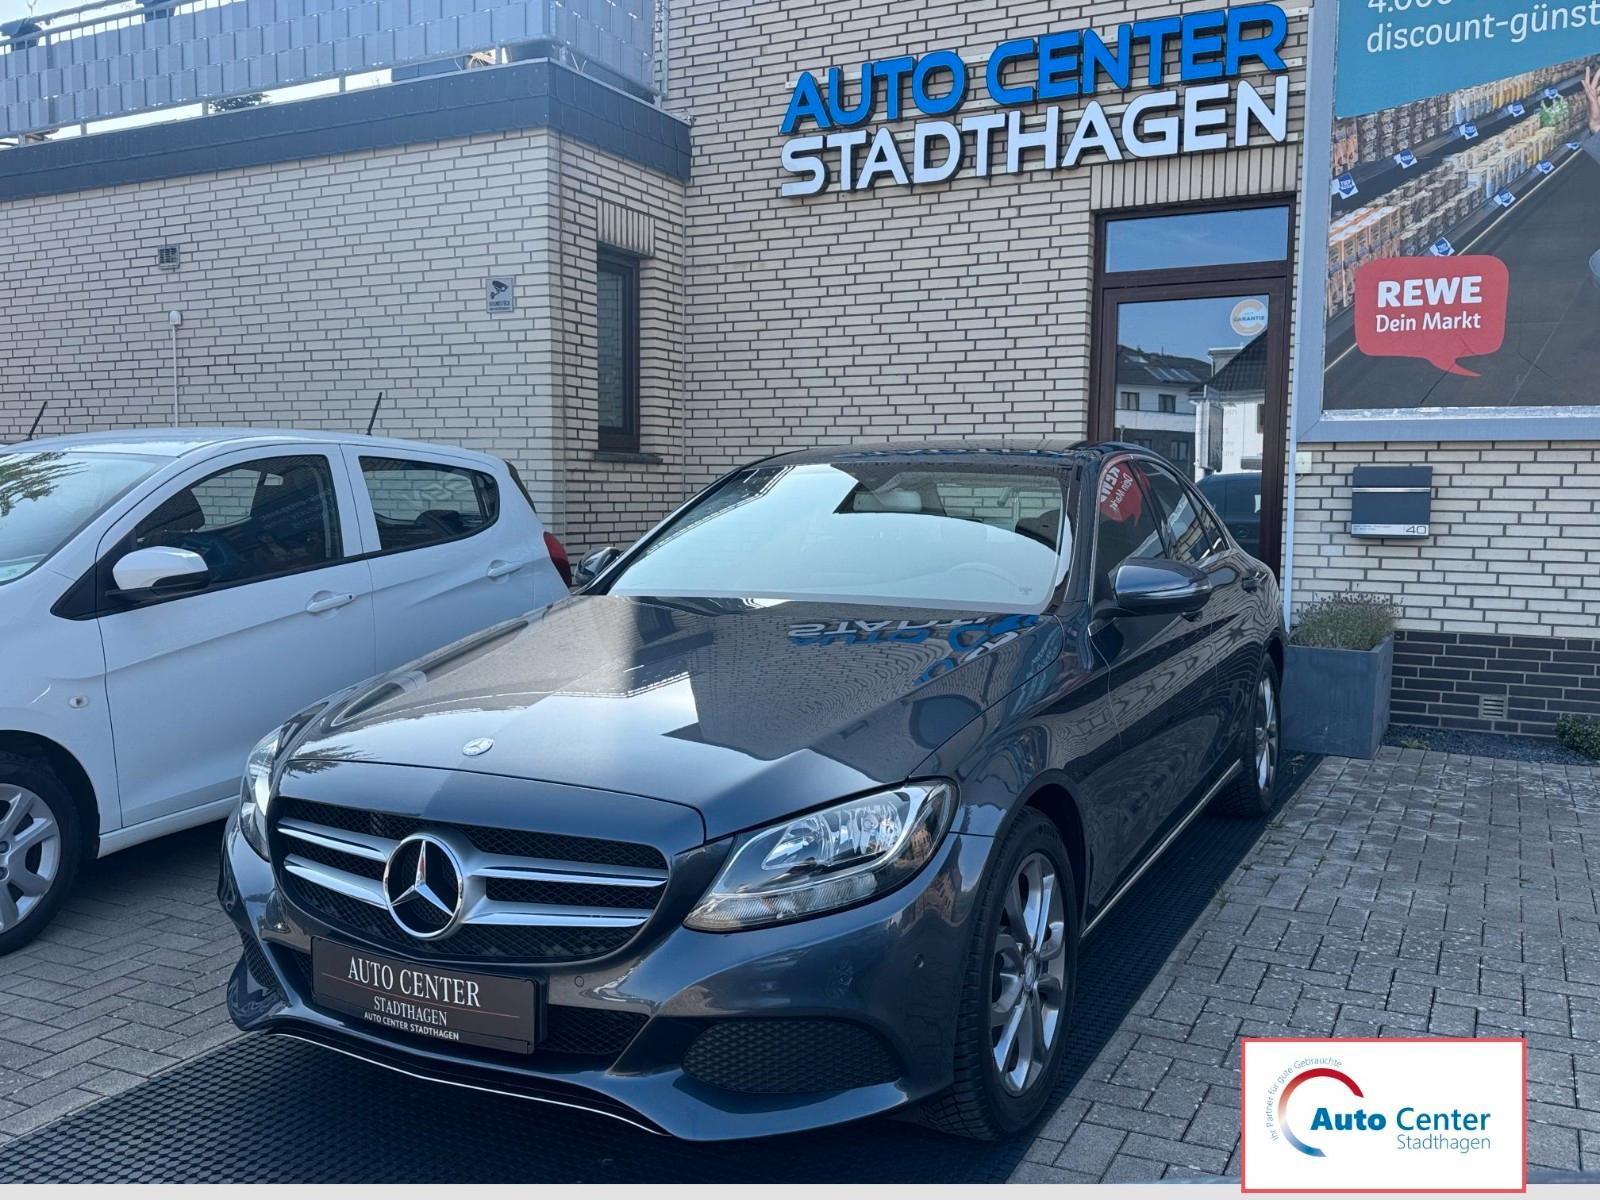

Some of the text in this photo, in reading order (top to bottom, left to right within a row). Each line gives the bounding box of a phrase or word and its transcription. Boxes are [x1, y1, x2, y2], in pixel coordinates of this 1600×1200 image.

[780, 3, 1288, 135] AUTO CENTER
[781, 75, 1289, 198] STADTHAGEN
[1377, 275, 1483, 308] REWE
[1375, 311, 1482, 333] Dein Markt
[1405, 525, 1427, 535] 40
[348, 956, 481, 1008] AUTO CENTER
[364, 1011, 459, 1041] AUTO CENTER STADTHAGEN
[374, 995, 448, 1027] STADTHAGEN
